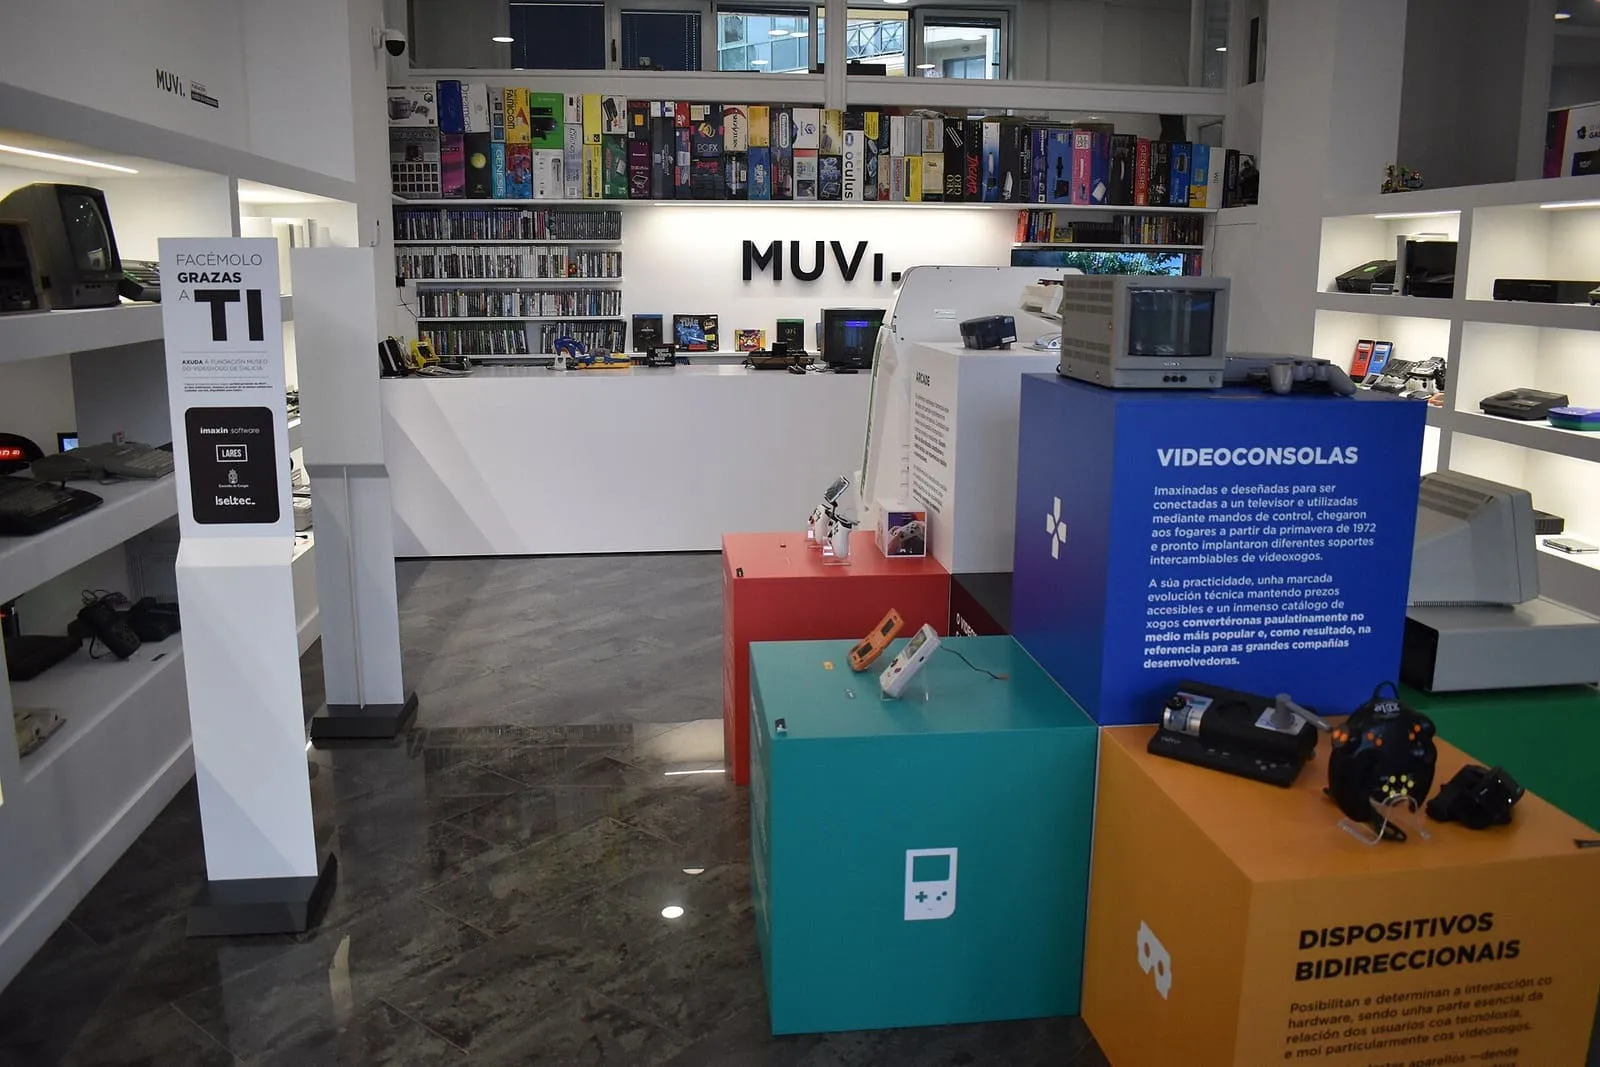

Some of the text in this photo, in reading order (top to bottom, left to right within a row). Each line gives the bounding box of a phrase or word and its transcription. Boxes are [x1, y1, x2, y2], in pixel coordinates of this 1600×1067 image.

[496, 149, 504, 197] GENESIS
[845, 152, 856, 199] oculus
[1139, 144, 1148, 192] GENESIS
[954, 174, 962, 195] GEO
[176, 251, 263, 266] FACÉMOLO
[177, 272, 242, 283] GRAZAS
[179, 289, 264, 341] A TI
[200, 426, 260, 435] imaxin software
[221, 448, 242, 458] LARES
[1157, 447, 1359, 467] VIDEOCONSOLAS
[1154, 484, 1336, 496] Imaxinadas e deseñadas para ser
[1153, 496, 1358, 510] conectadas a un televisor e utilizadas
[1152, 510, 1367, 524] mediante mandos de control, chegaron
[1151, 523, 1377, 540] aos fogares a partir da primavera de 1972
[1151, 537, 1375, 553] e pronto implantaron diferentes soportes
[1150, 551, 1324, 566] intercambiables de videoxogos.
[1149, 573, 1333, 590] A súa practicidade, unha marcada
[1147, 587, 1340, 603] evolución técnica mantendo prezos
[1146, 599, 1345, 616] accesibles e un inmenso catálogo de
[1146, 612, 1365, 631] xogos convertéronas paulatinamente no
[1145, 631, 1181, 643] medio
[1183, 630, 1210, 641] máis
[1212, 629, 1255, 642] popular
[1270, 628, 1300, 638] como
[1302, 626, 1356, 637] resultado,
[1358, 625, 1372, 635] na
[1144, 639, 1349, 656] referencia para as grandes compañías
[1143, 656, 1240, 669] desenvolvedoras.
[1298, 912, 1494, 950] DISPOSITIVOS
[1295, 939, 1521, 982] BIDIRECCIONAIS
[1290, 997, 1360, 1014] Posibilitan
[1364, 997, 1372, 1006] e
[1376, 986, 1450, 1005] determinan
[1453, 987, 1462, 997] a
[1465, 978, 1534, 995] interacción
[1288, 1014, 1354, 1029] hardware,
[1358, 1008, 1398, 1022] sendo
[1402, 1003, 1433, 1017] unha
[1437, 1000, 1471, 1014] parte
[1474, 992, 1526, 1008] esencial
[1286, 1028, 1340, 1044] relación
[1343, 1027, 1367, 1038] dos
[1371, 1019, 1425, 1035] usuarios
[1429, 1016, 1452, 1028] coa
[1284, 1050, 1292, 1060] e
[1296, 1046, 1322, 1058] moi
[1325, 1034, 1430, 1056] particularmente
